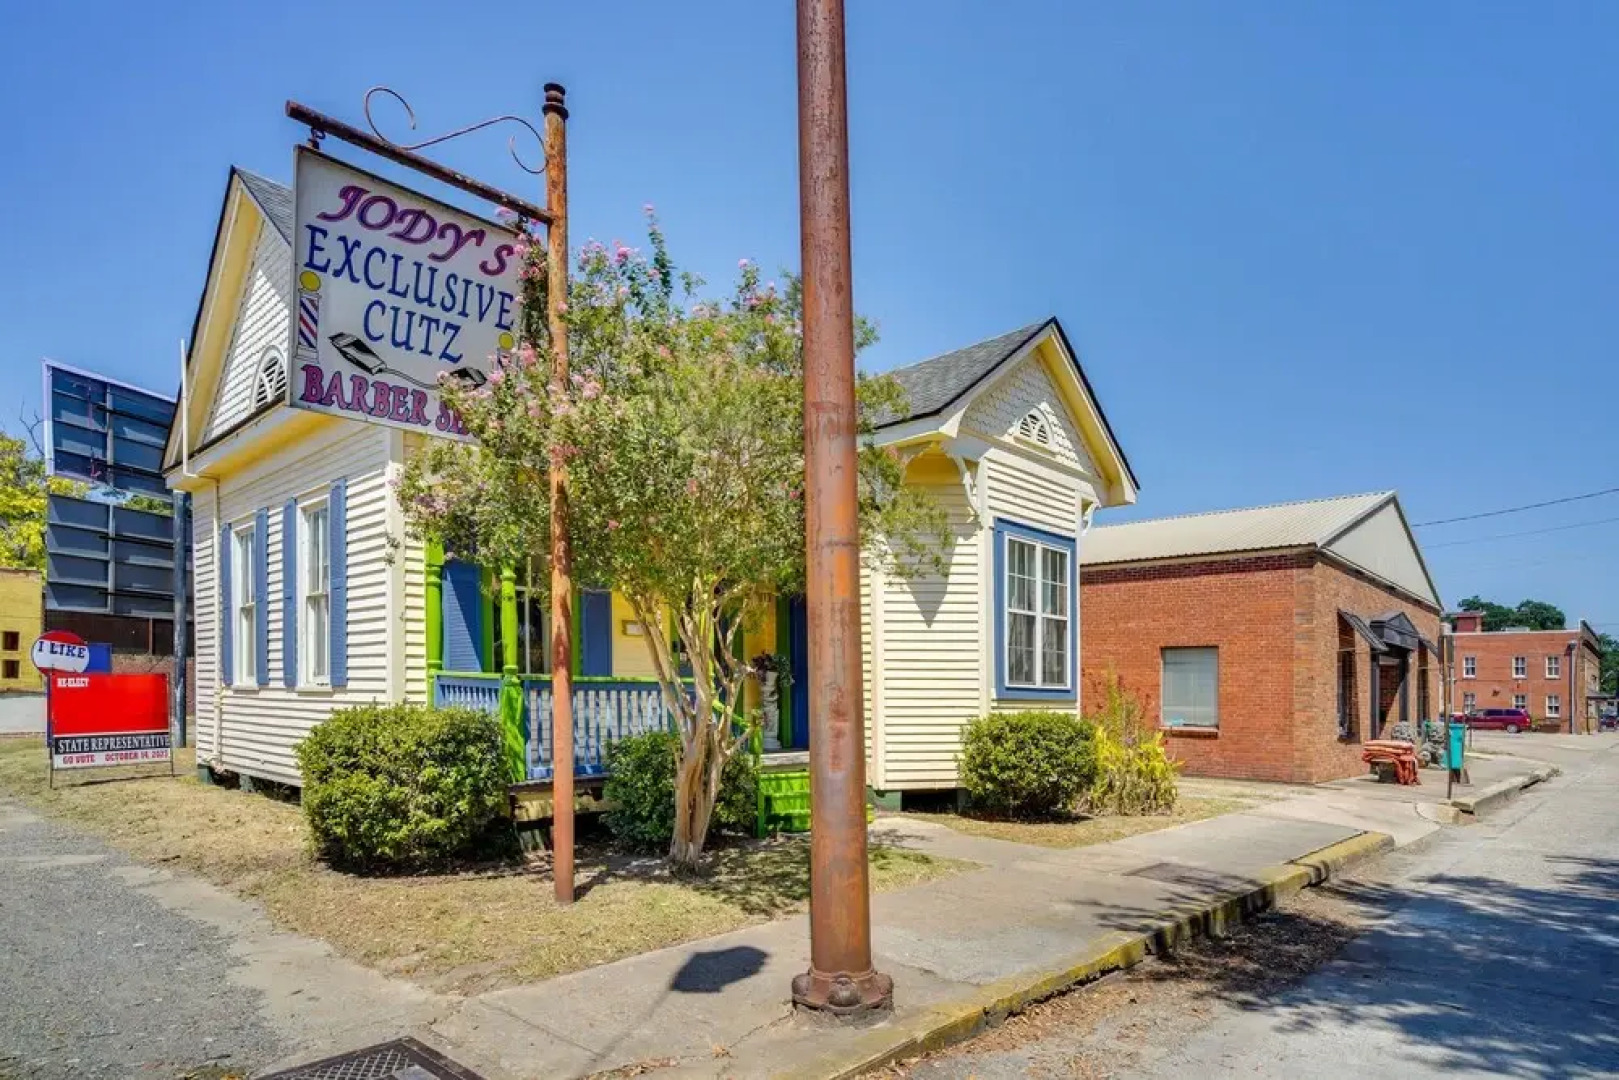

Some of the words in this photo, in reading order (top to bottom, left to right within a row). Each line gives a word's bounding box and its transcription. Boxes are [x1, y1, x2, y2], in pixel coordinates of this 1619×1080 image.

[317, 185, 515, 276] JODY'S
[304, 224, 514, 331] EXCLUSIVE
[363, 300, 464, 364] CUTZ
[300, 364, 431, 426] BARBER
[38, 640, 45, 652] I
[49, 642, 87, 658] LIKE
[58, 739, 91, 753] STATE
[91, 734, 170, 751] REPRESENTATIVE
[63, 755, 74, 765] GO
[76, 754, 96, 764] VOTE
[105, 751, 138, 762] OCTOBER
